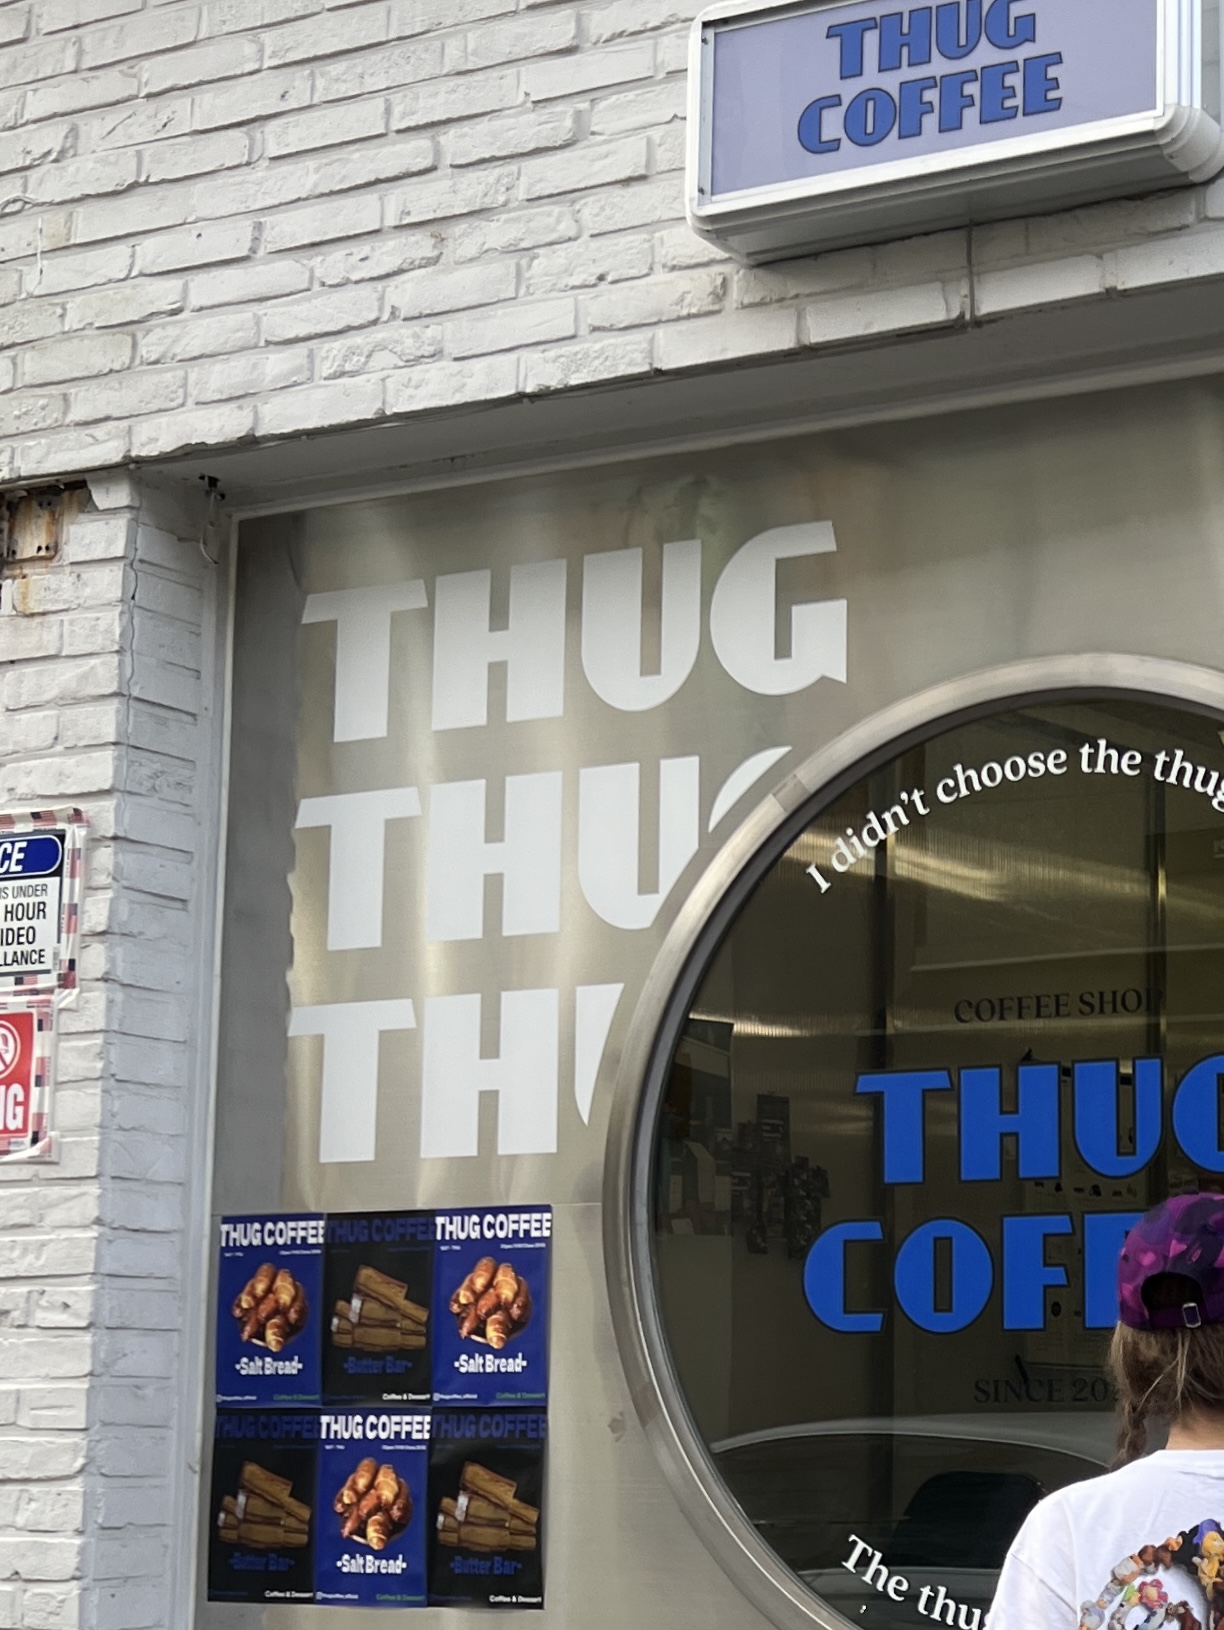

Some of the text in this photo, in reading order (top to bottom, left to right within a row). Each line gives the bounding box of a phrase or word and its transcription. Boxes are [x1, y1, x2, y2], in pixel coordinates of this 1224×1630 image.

[826, 0, 1036, 80] THUG
[798, 52, 1064, 154] COFFEE
[301, 520, 848, 743] THUG
[804, 862, 832, 894] I
[935, 746, 1067, 804] choose
[1080, 738, 1142, 775] the
[12, 883, 48, 899] UNDER
[4, 901, 47, 922] HOUR
[954, 993, 1071, 1024] COFFEE
[220, 1220, 325, 1247] THUG COFFEE
[435, 1213, 552, 1241] THUG COFFEE
[973, 1377, 1065, 1404] SINCE
[320, 1414, 432, 1440] THUG COFFEE
[841, 1534, 910, 1602] The
